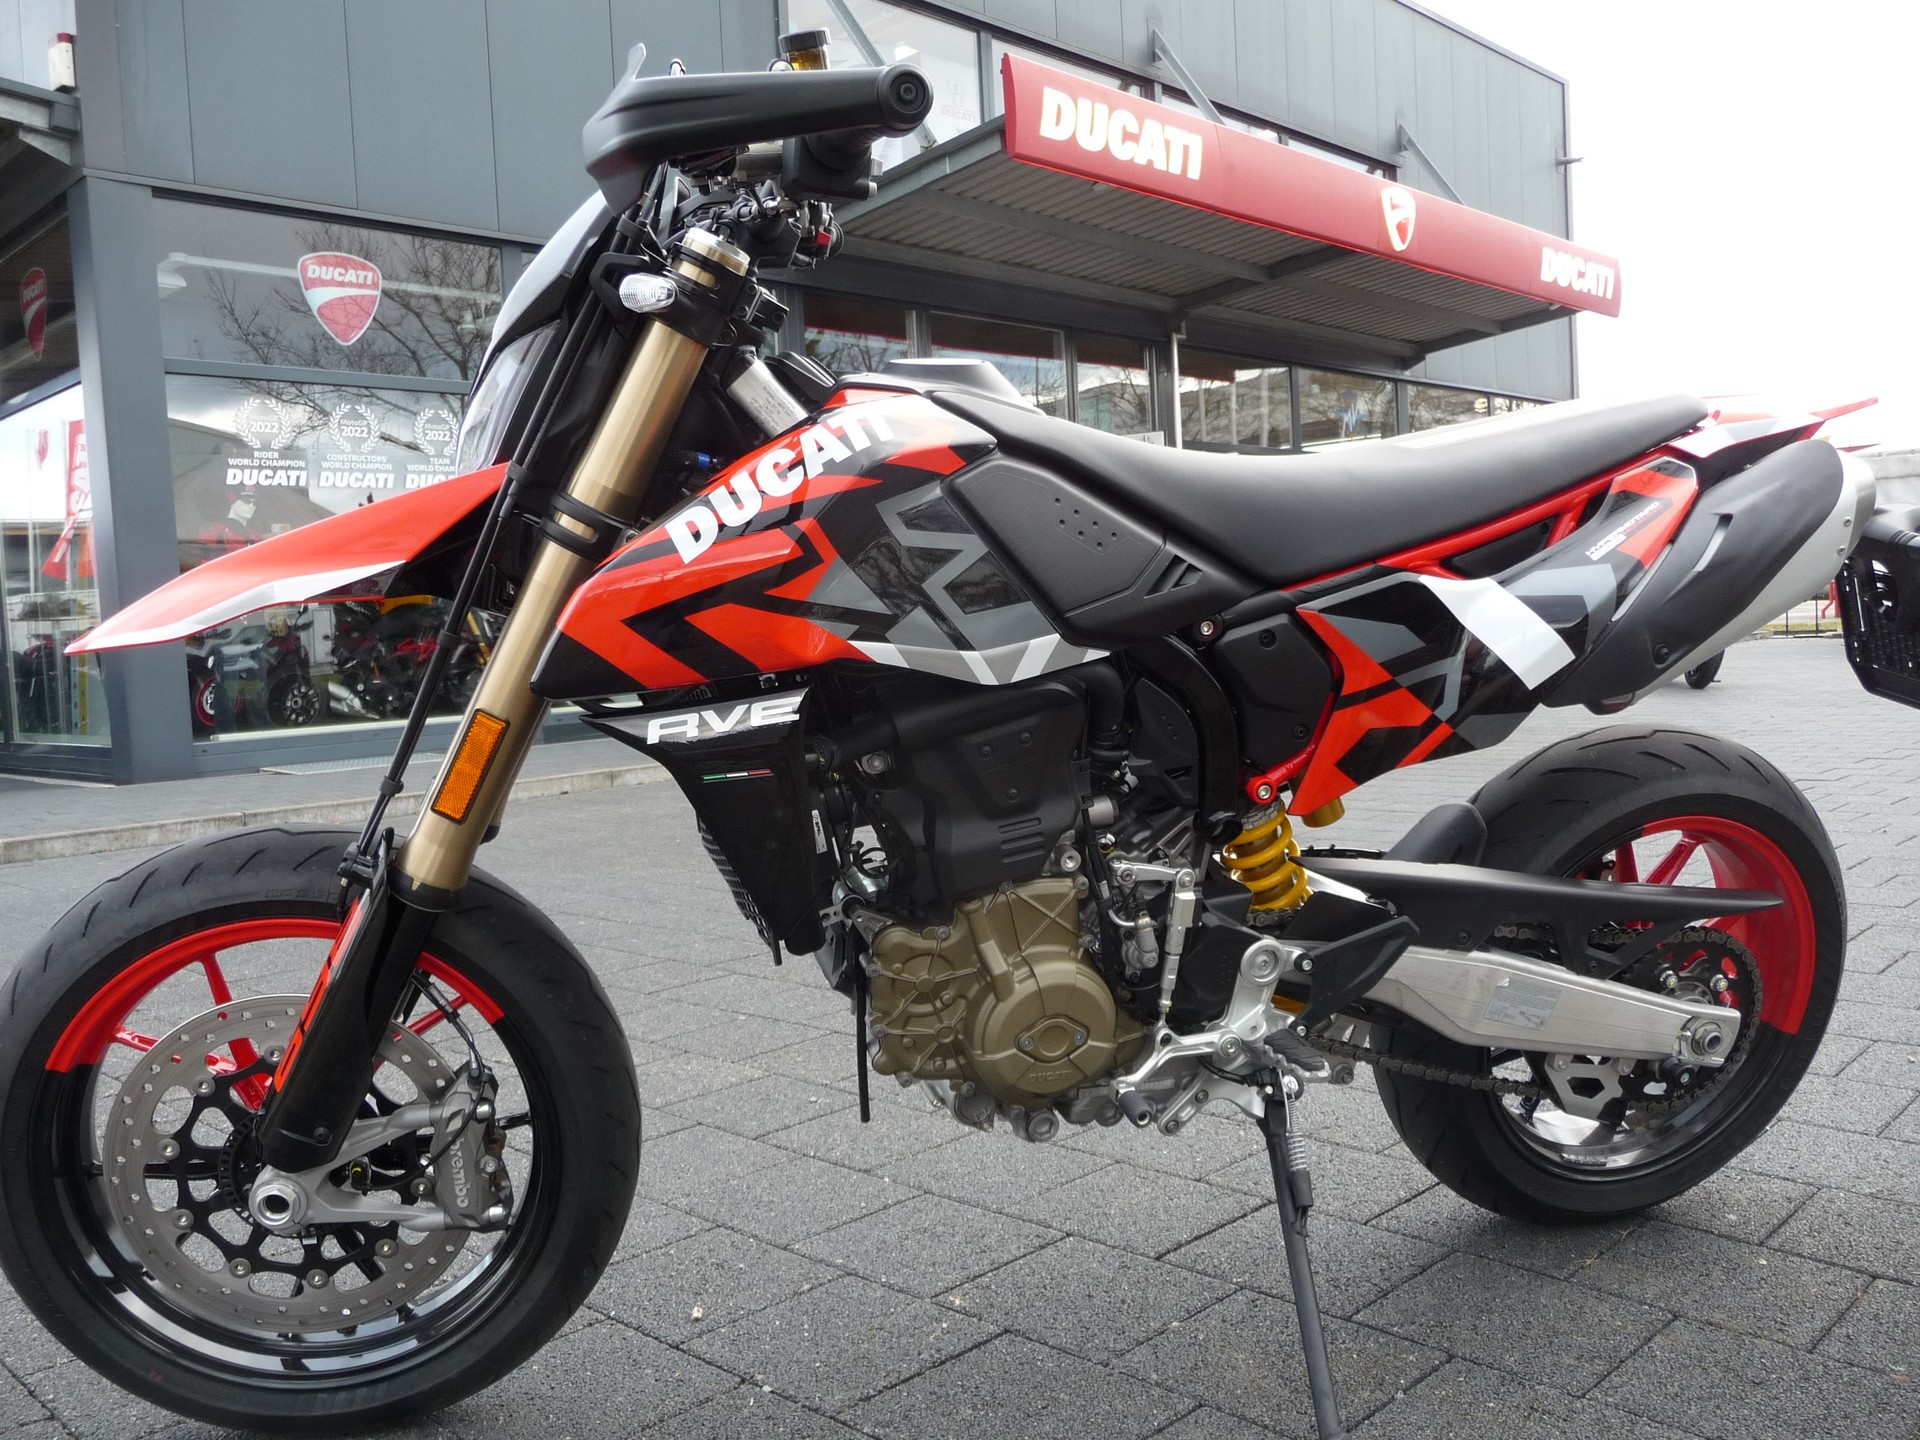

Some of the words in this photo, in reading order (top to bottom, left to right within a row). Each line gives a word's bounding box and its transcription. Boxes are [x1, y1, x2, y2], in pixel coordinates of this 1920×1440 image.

[1039, 86, 1203, 180] DUCATI
[307, 264, 373, 285] DUCATI
[1540, 246, 1615, 300] DUCATI
[249, 421, 279, 433] 2022
[341, 426, 369, 437] 2022
[425, 430, 451, 441] 2022
[254, 451, 279, 459] RIDER
[429, 457, 450, 465] TEAM
[228, 458, 260, 467] WORLD
[261, 459, 306, 468] CHAMPION
[321, 461, 350, 469] WORLD
[351, 462, 393, 471] CHAMPION
[407, 464, 434, 472] WORLD
[435, 464, 456, 473] CHAM
[226, 469, 308, 487] DUCATI
[319, 471, 394, 489] DUCATI
[664, 411, 896, 565] DUCATI
[646, 696, 802, 745] RVE
[450, 1136, 471, 1208] brembo
